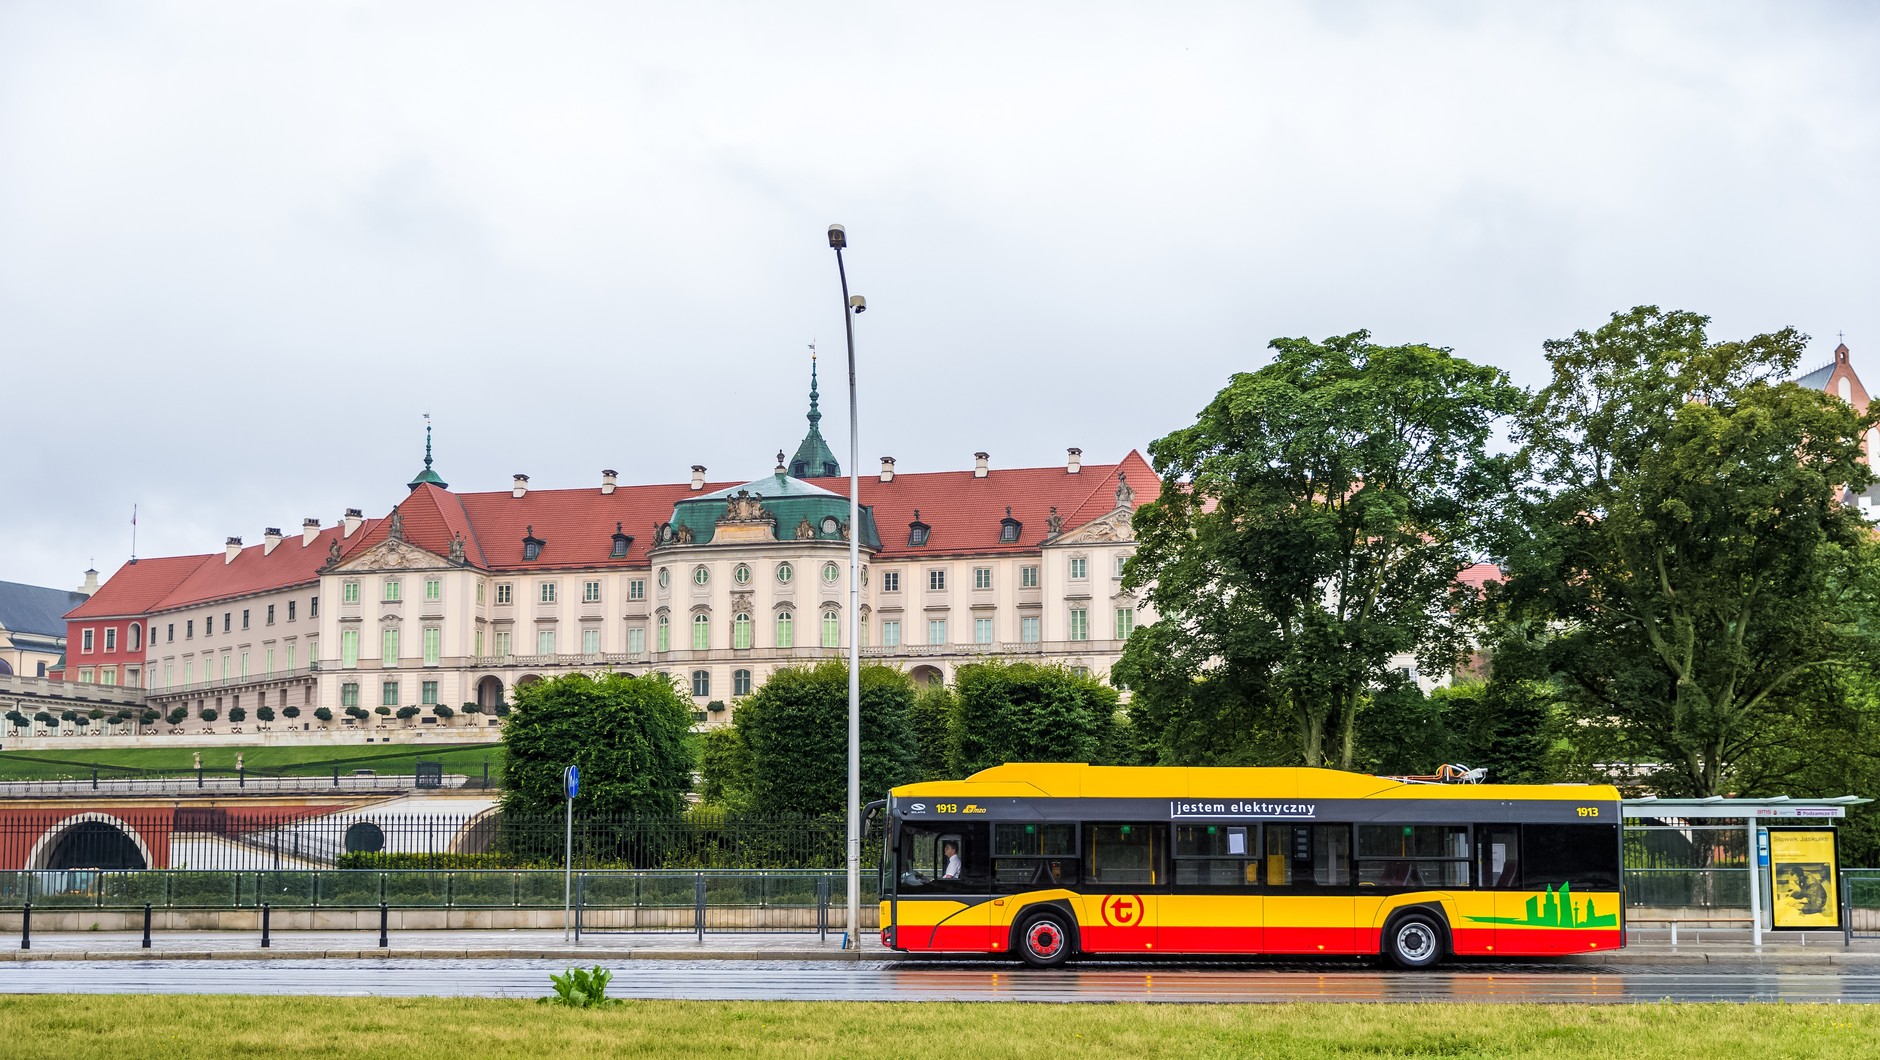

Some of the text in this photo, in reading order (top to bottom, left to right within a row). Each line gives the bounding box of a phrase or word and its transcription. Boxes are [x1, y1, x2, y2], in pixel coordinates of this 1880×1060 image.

[936, 803, 957, 814] 1913
[1177, 801, 1315, 815] jestem elektryczny
[1576, 807, 1599, 817] 1913
